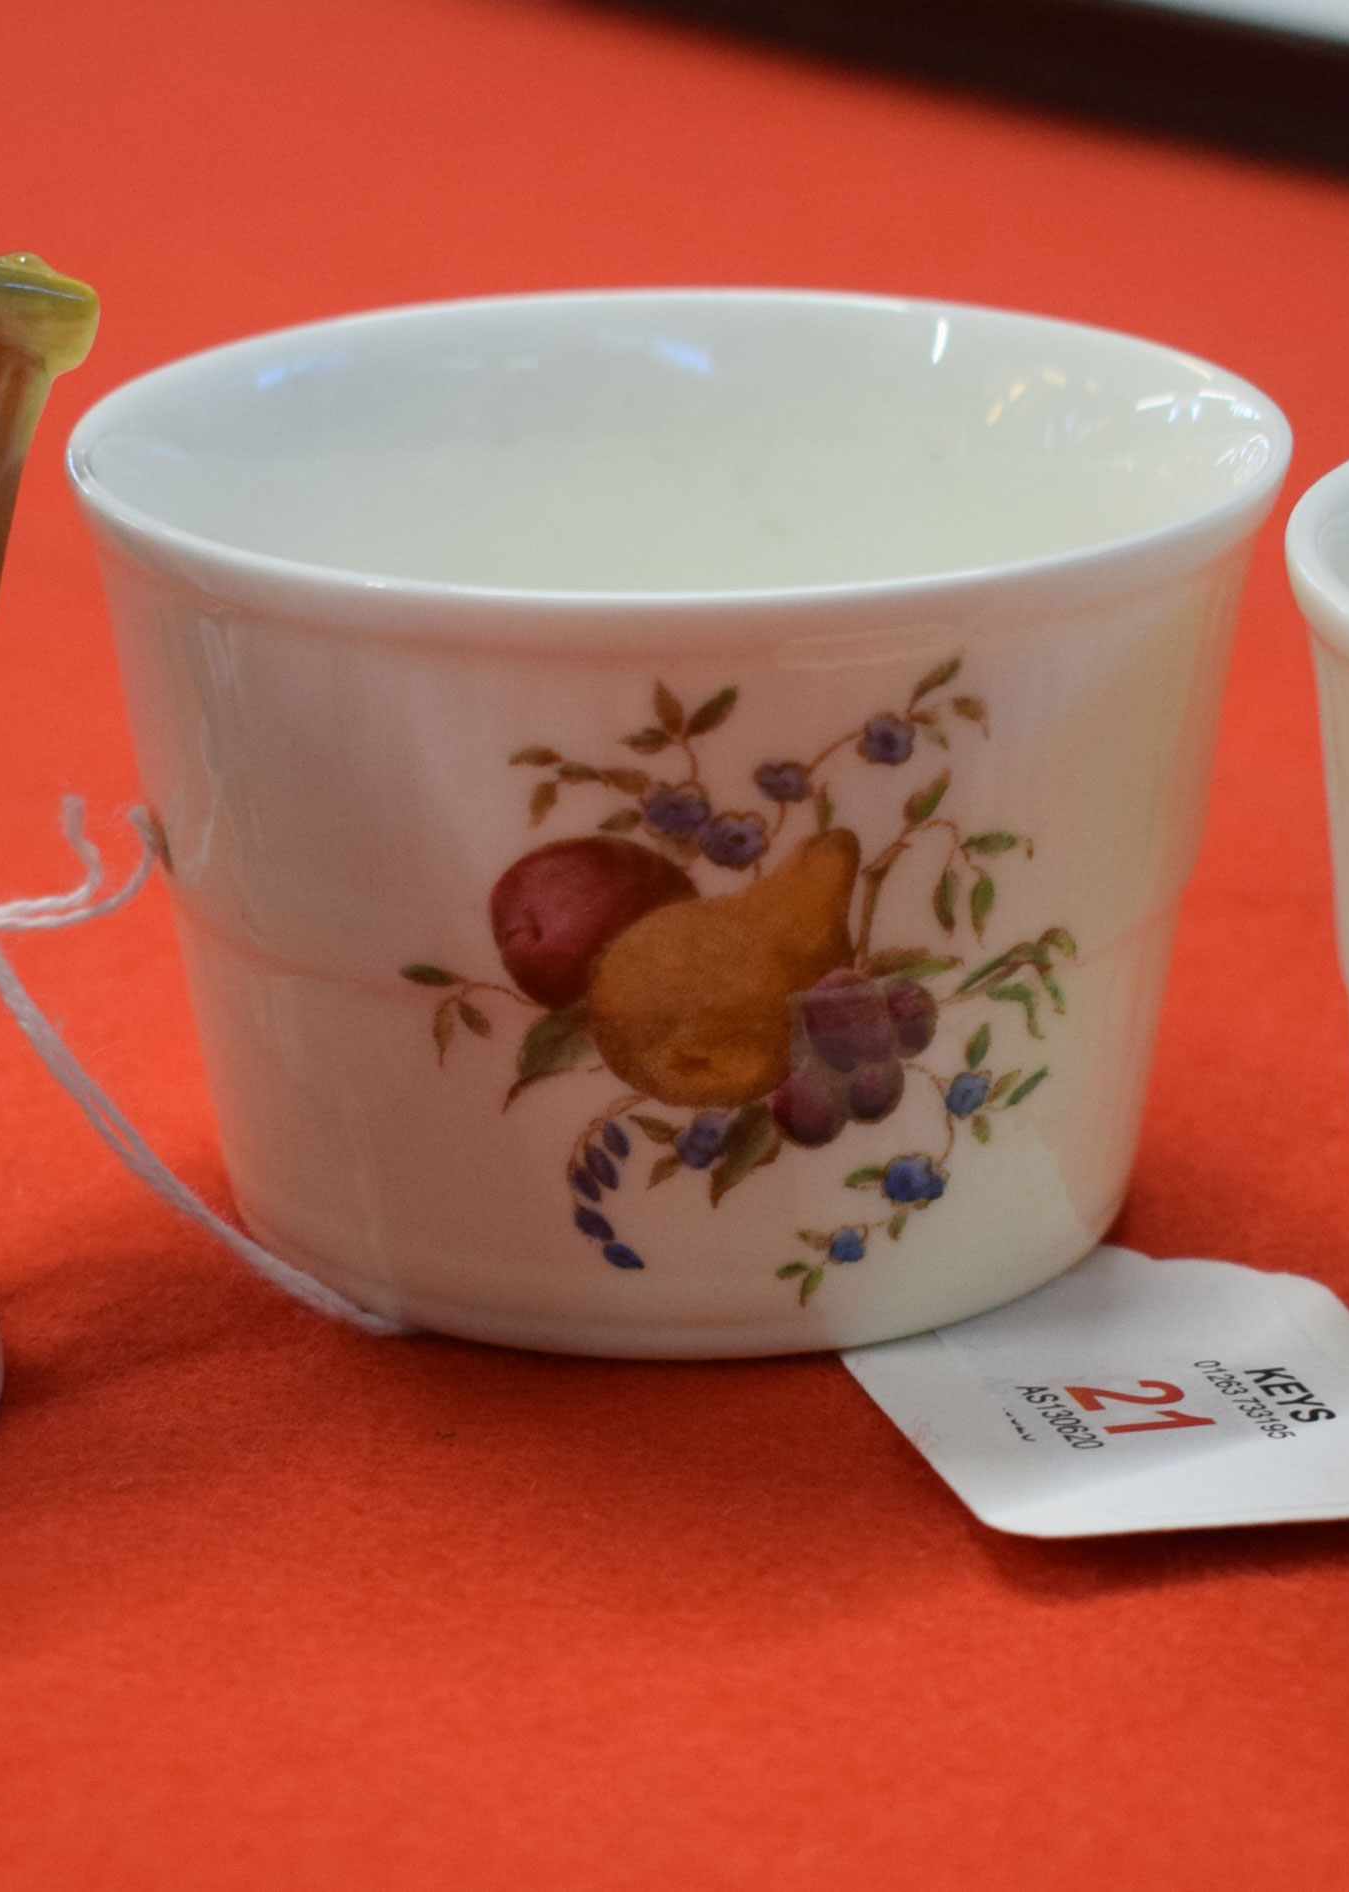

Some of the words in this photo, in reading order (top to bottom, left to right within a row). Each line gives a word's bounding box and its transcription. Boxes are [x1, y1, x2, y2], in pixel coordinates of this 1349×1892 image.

[1014, 1386, 1104, 1449] AS130620
[1063, 1380, 1217, 1434] 21
[1194, 1360, 1248, 1395] 01263
[1232, 1397, 1296, 1439] 733195
[1243, 1367, 1336, 1422] KEYS
